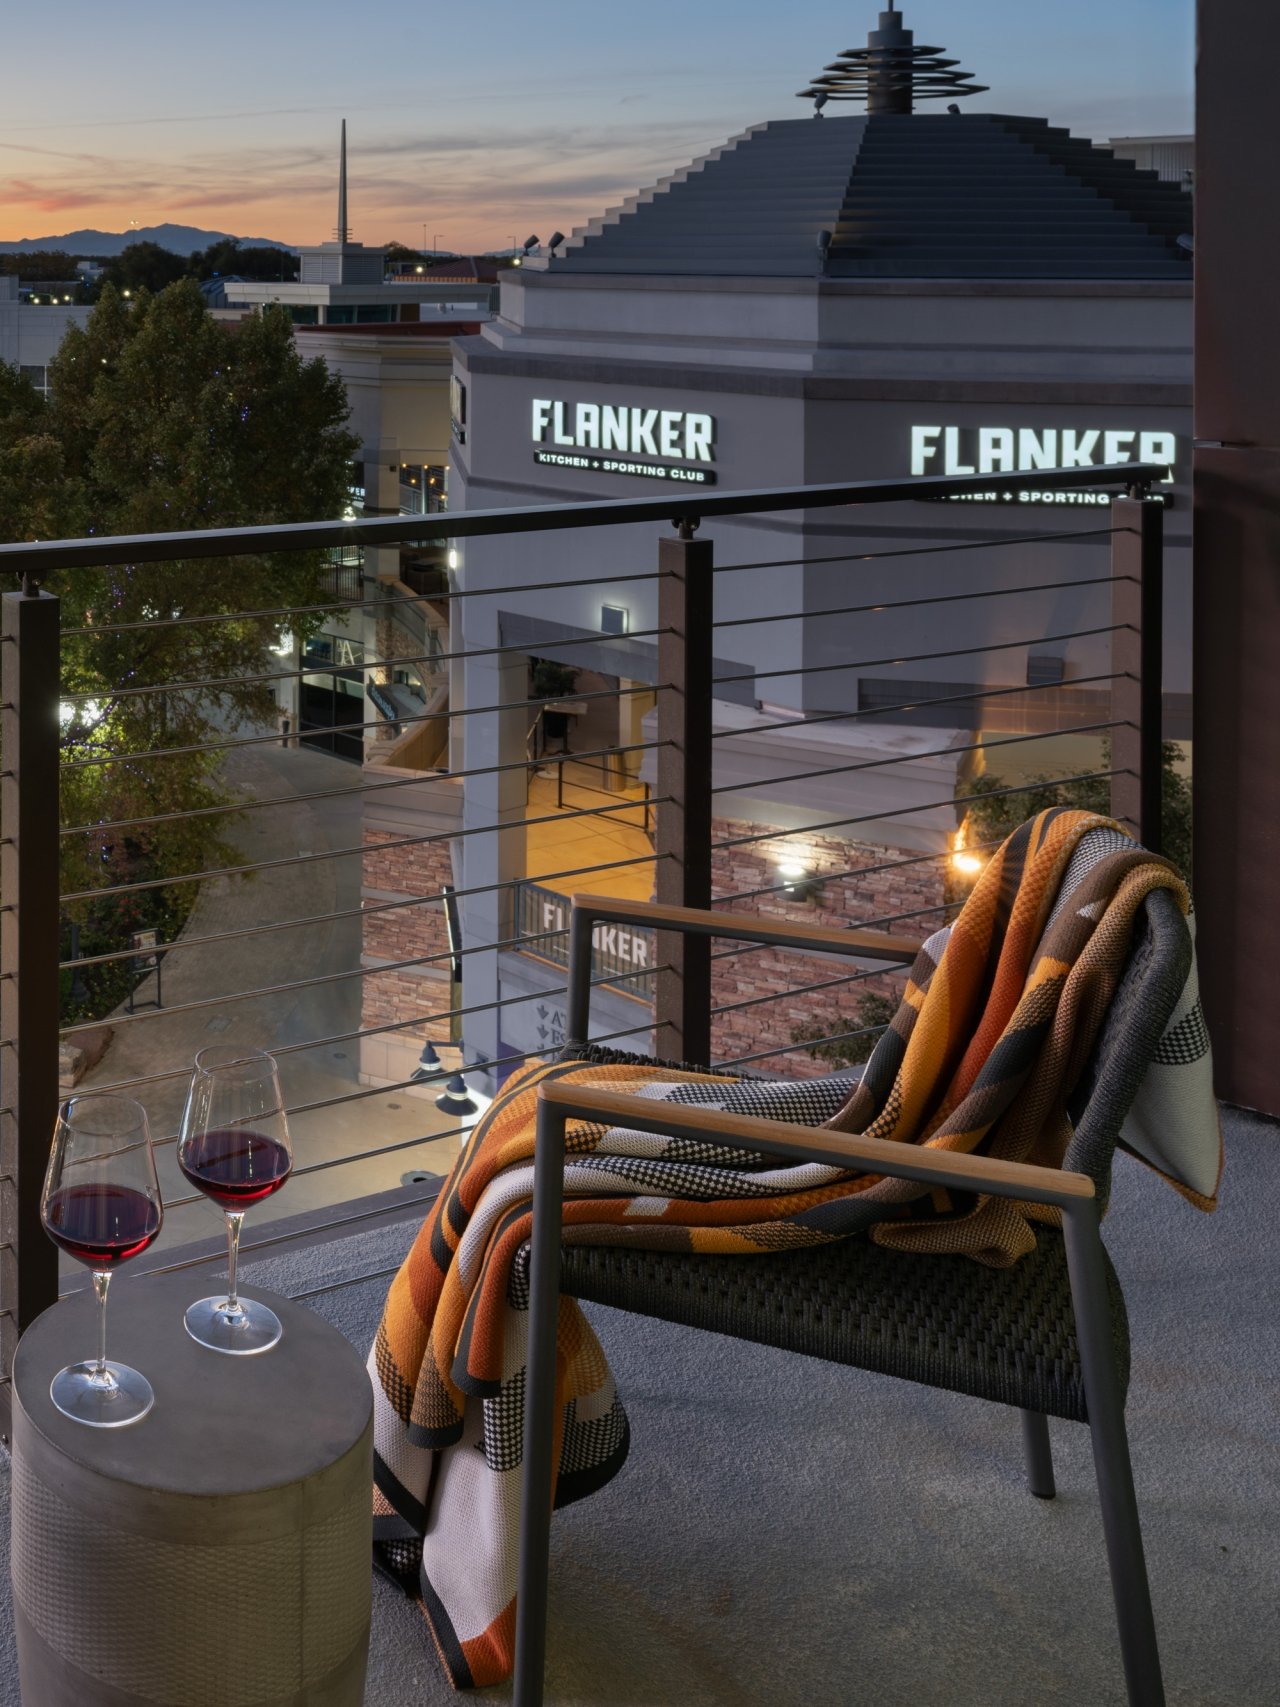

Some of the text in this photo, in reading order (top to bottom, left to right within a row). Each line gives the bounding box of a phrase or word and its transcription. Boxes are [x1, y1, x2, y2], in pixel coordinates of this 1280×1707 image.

[532, 399, 712, 462] FLANKER
[911, 426, 1176, 483] FLANKER
[539, 453, 589, 467] KITCHEN
[603, 461, 666, 477] SPORTING
[670, 468, 705, 482] CLUB
[1019, 490, 1110, 504] SPORTING
[543, 902, 648, 967] FLKER
